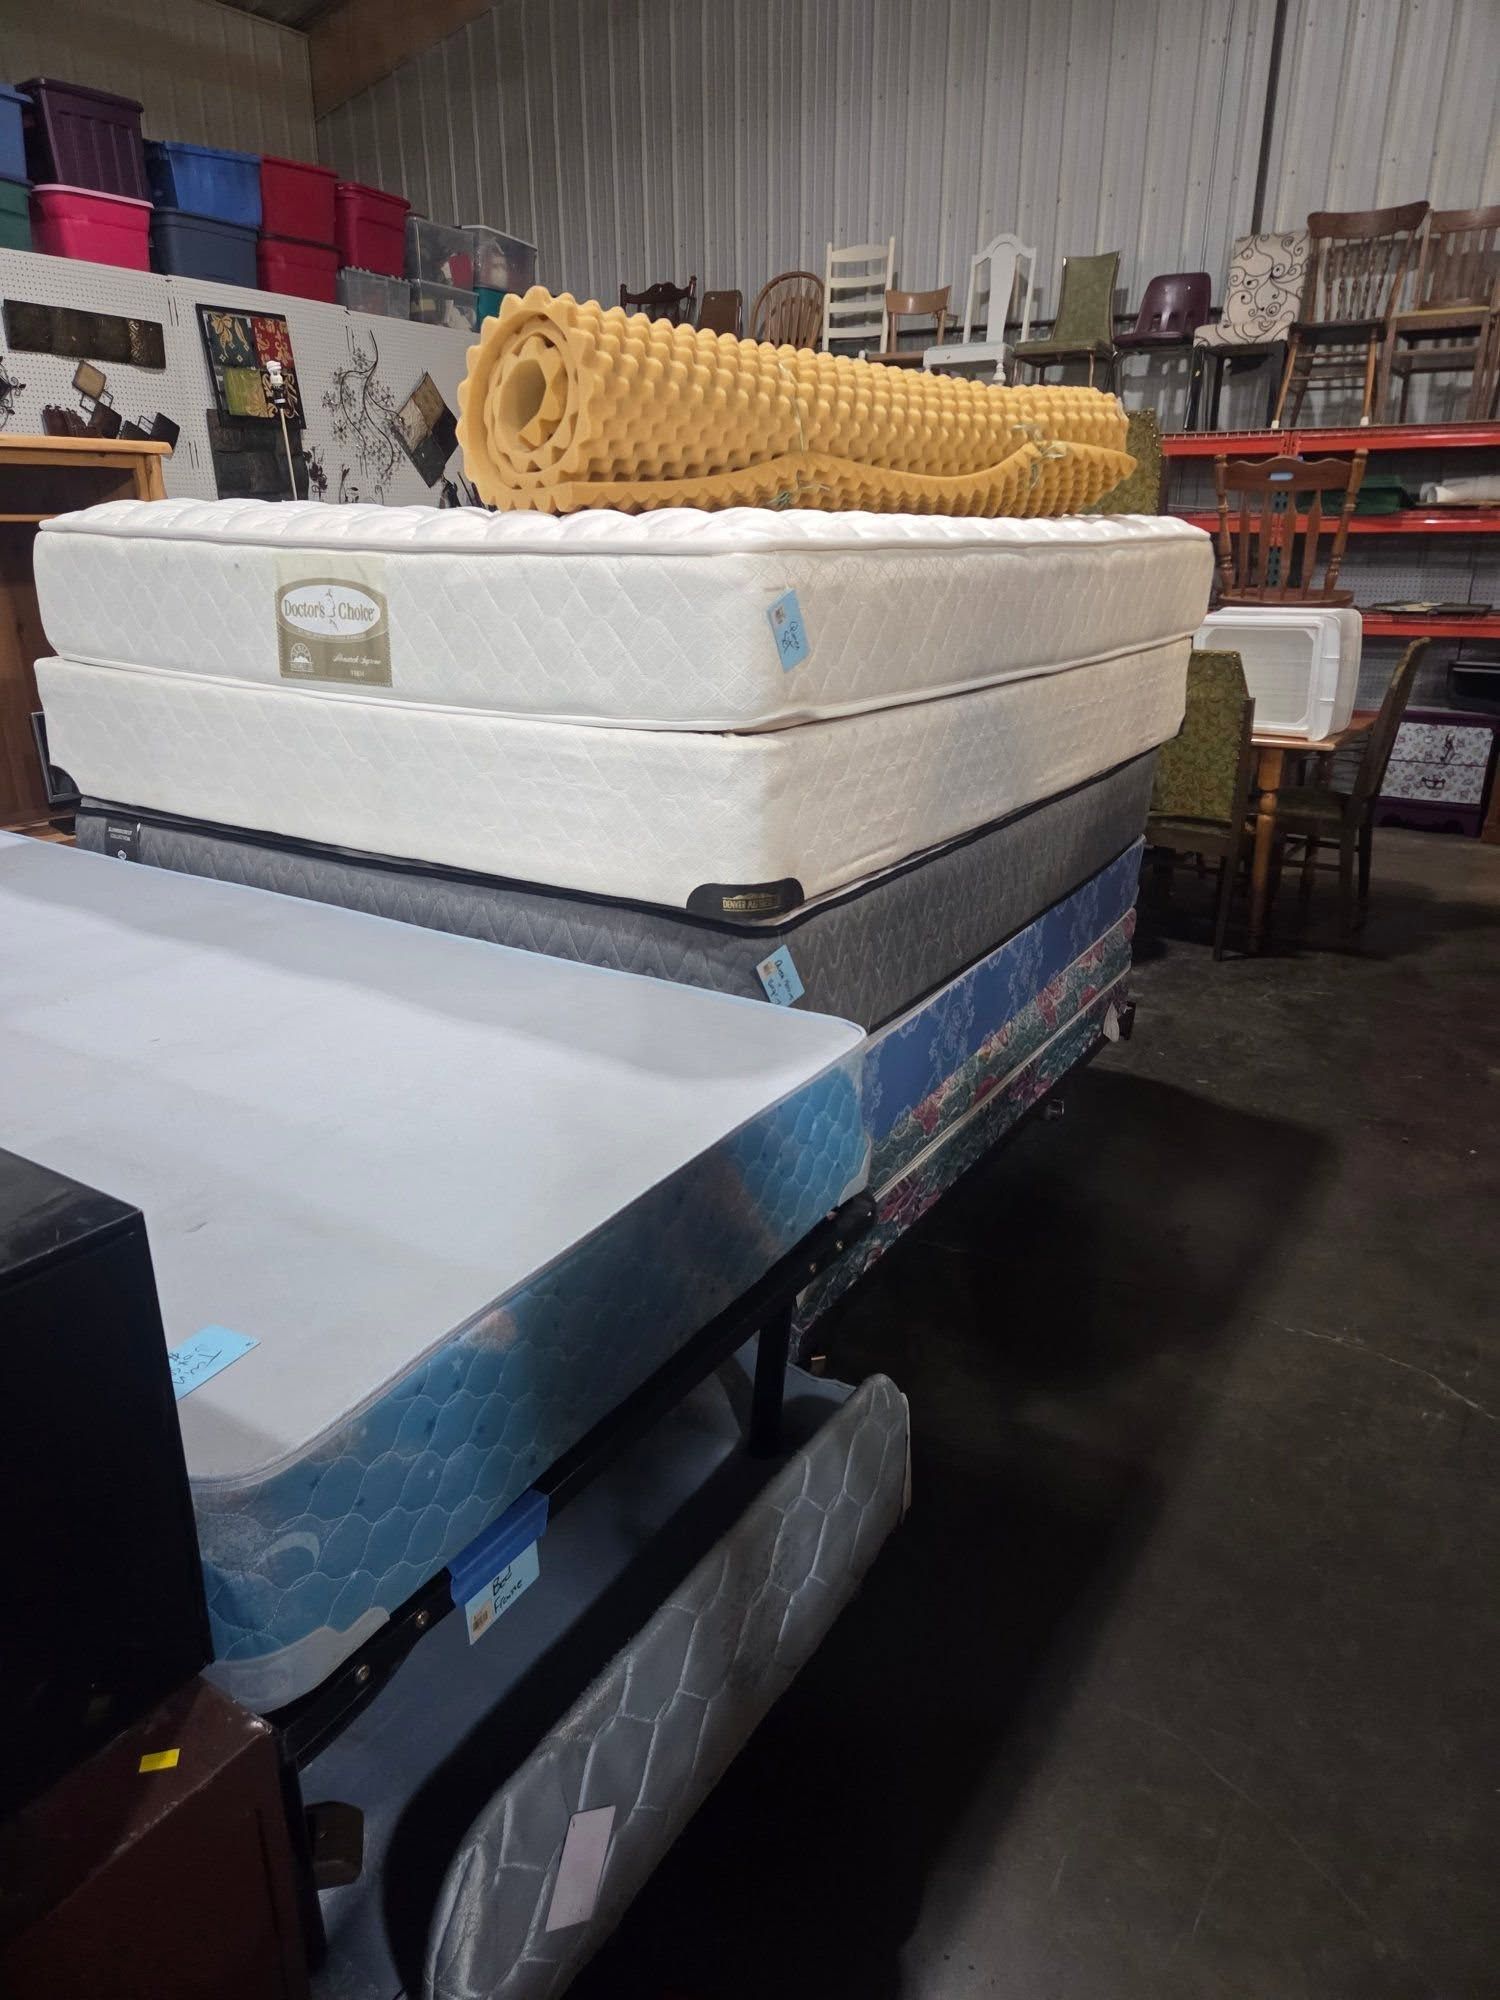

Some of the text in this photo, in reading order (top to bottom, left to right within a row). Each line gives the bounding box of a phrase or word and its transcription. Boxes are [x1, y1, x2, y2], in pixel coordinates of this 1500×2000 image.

[284, 600, 374, 621] Doctor's Choice
[493, 1565, 513, 1596] Bed
